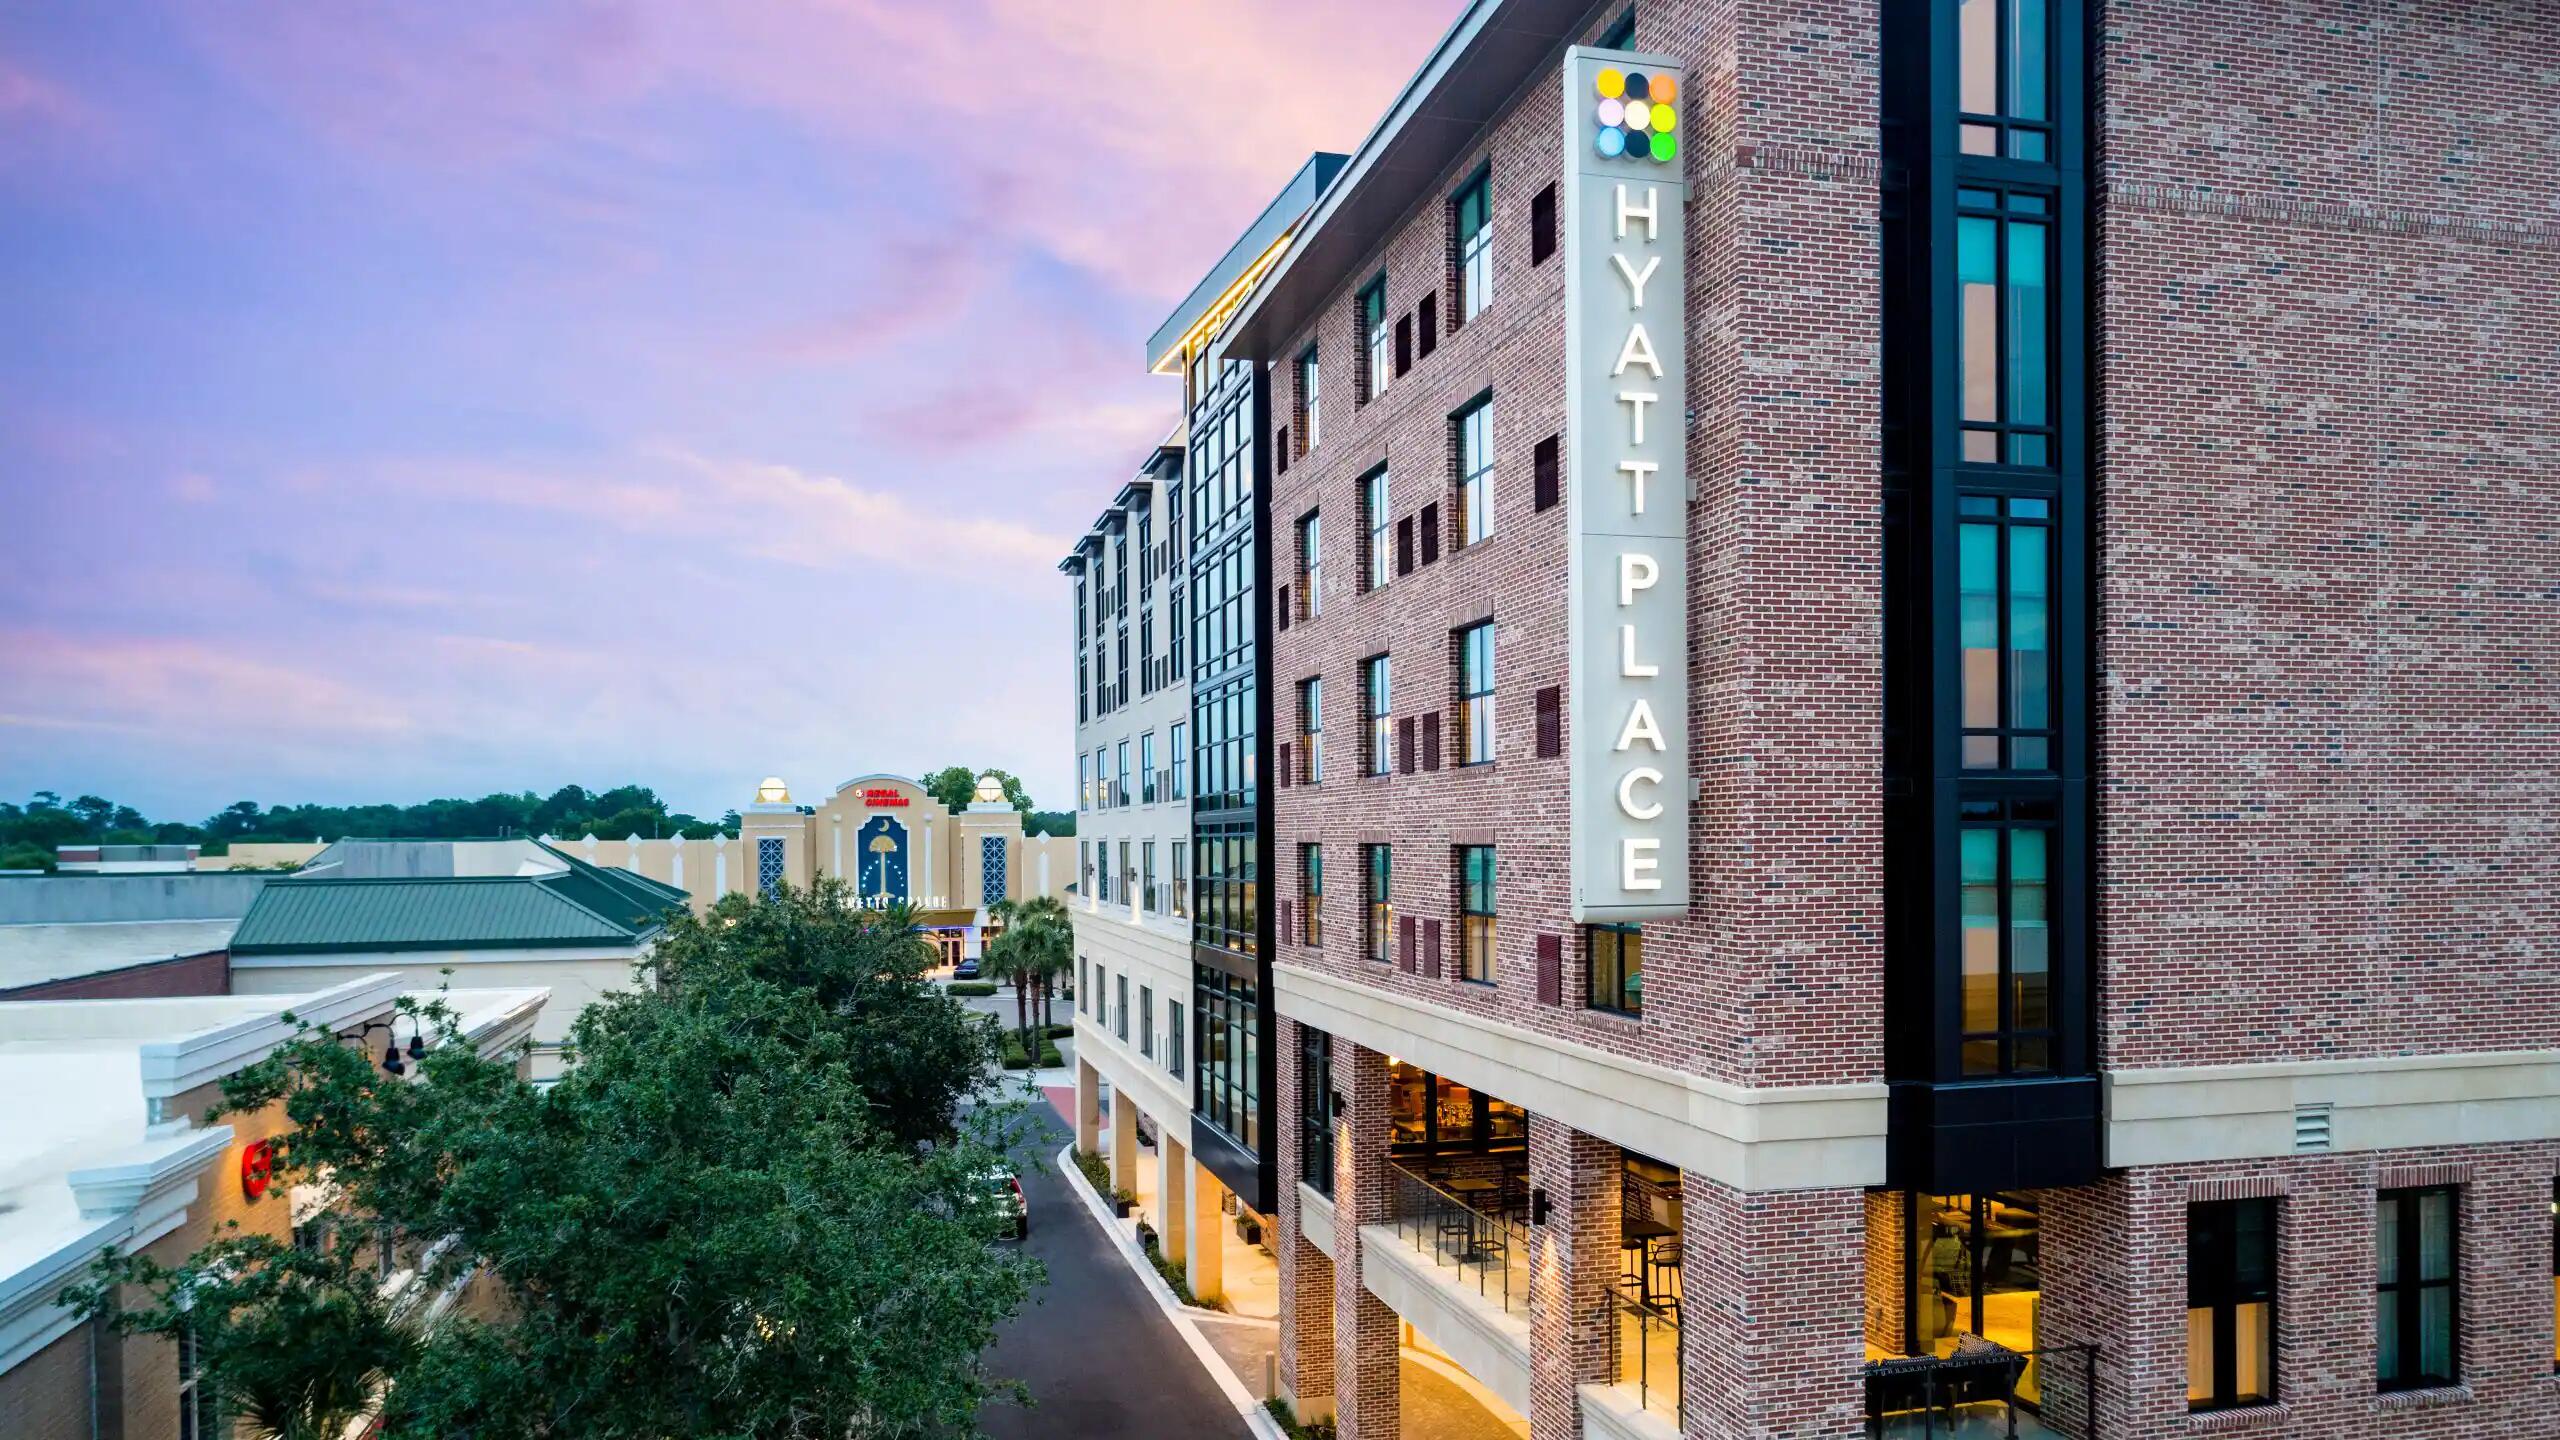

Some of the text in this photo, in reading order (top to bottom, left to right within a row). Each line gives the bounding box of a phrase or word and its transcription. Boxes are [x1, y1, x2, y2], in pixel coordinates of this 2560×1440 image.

[1610, 184, 1667, 890] HYATT PLACE
[865, 798, 910, 807] CINEMAS
